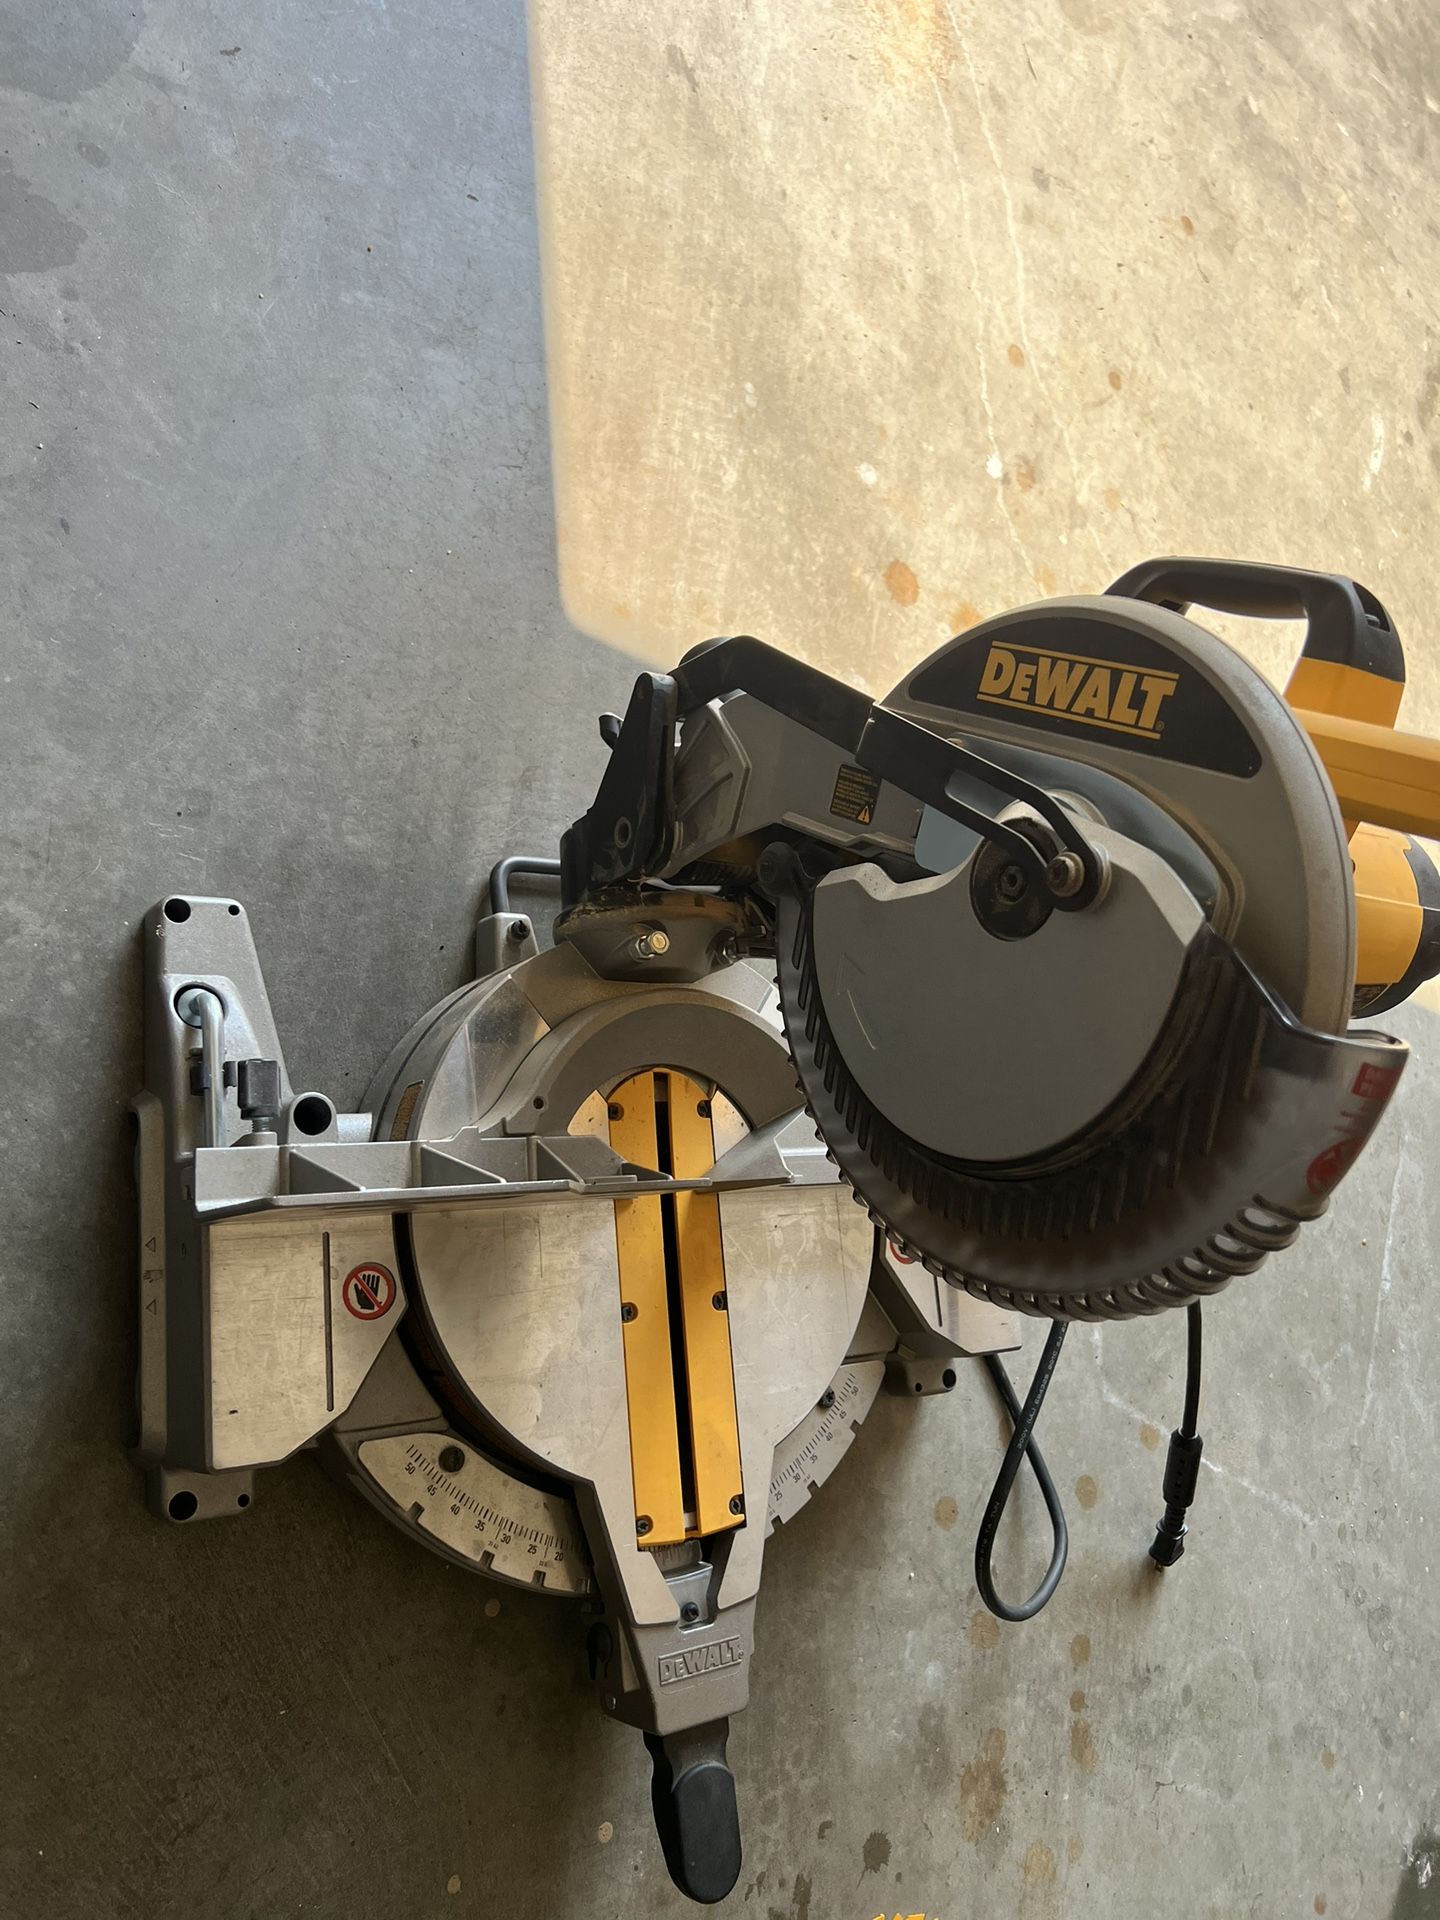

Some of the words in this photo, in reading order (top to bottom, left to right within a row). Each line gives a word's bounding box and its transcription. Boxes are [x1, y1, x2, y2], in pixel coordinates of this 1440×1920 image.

[978, 646, 1178, 731] DEWALT
[851, 1386, 860, 1396] 50
[838, 1410, 847, 1420] 45
[825, 1432, 834, 1442] 40
[810, 1454, 818, 1464] 35
[404, 1463, 415, 1475] 50
[792, 1474, 801, 1484] 30
[427, 1484, 437, 1496] 45
[774, 1491, 783, 1501] 25
[450, 1504, 461, 1515] 40
[474, 1520, 485, 1532] 35
[501, 1534, 511, 1545] 30
[527, 1543, 538, 1555] 25
[554, 1551, 564, 1562] 20
[660, 1640, 741, 1681] DEWALT
